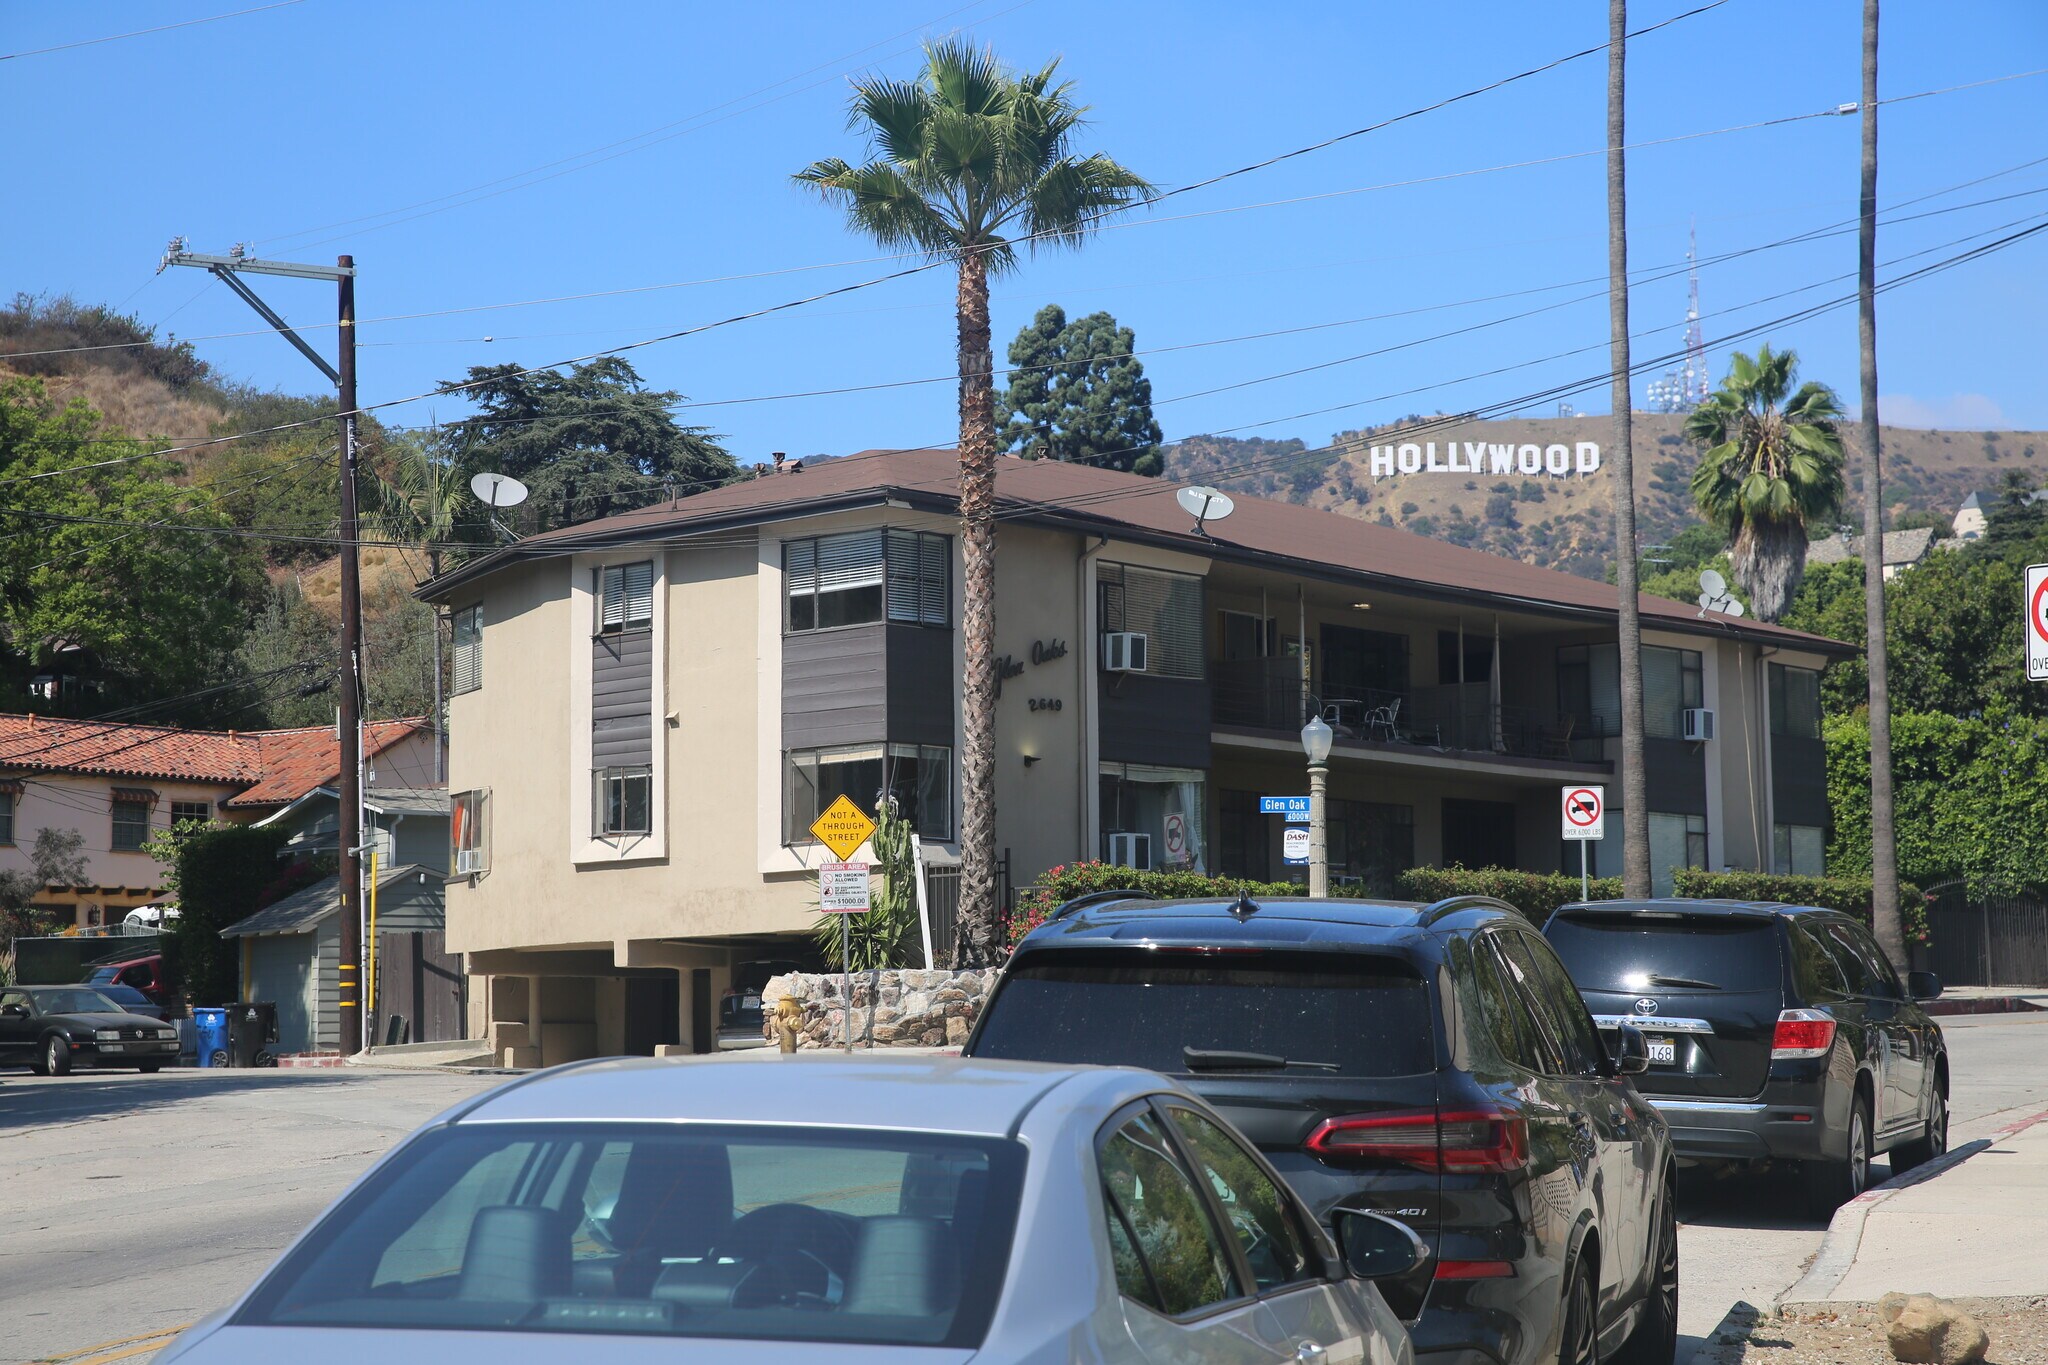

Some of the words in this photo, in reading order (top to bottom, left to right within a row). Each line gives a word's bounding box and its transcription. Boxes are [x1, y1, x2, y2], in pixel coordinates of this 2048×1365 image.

[1371, 442, 1600, 476] HOLLYWOOD
[1028, 698, 1062, 712] 2649
[1265, 799, 1285, 810] Glen
[1289, 799, 1305, 810] Oak
[830, 811, 847, 819] NOT
[850, 811, 857, 819] A
[822, 822, 865, 830] THROUGH
[827, 833, 860, 841] STREET
[1286, 833, 1309, 841] DASH
